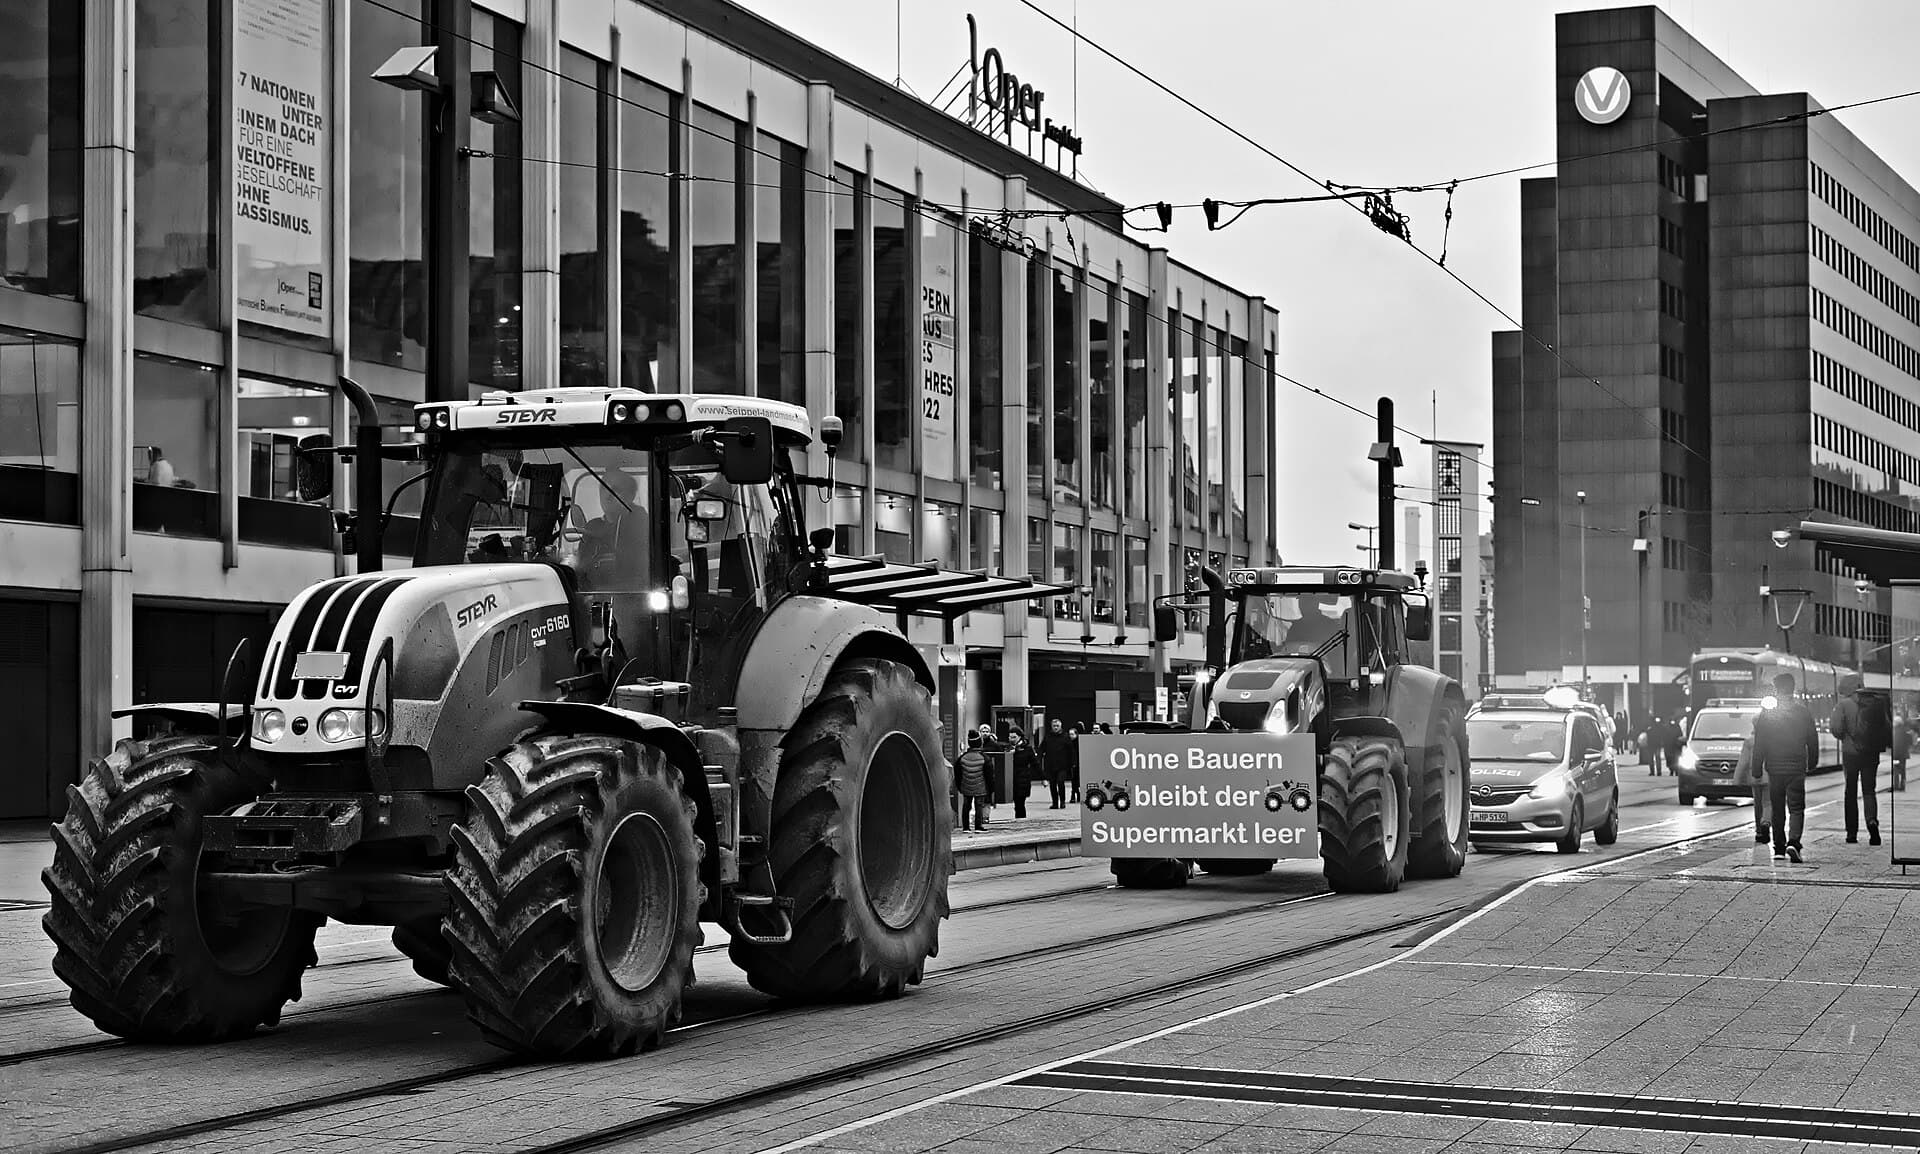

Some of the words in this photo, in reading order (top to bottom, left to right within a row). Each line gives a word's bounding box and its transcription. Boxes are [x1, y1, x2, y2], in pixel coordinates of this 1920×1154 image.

[251, 74, 315, 110] NATIONEN
[983, 48, 1044, 134] Oper
[237, 106, 276, 134] INEM
[281, 121, 315, 146] DACH
[282, 103, 322, 130] UNTER
[240, 125, 264, 149] FÜR
[266, 135, 293, 158] EINE
[237, 201, 312, 235] ASSISMUS.
[924, 369, 953, 397] HRES
[496, 408, 556, 424] STEYR
[923, 397, 940, 421] 22
[457, 593, 498, 629] STEYR
[531, 625, 547, 639] CVT
[546, 614, 570, 633] 6160
[334, 685, 358, 693] CVT
[1110, 747, 1179, 770] Ohne
[1187, 747, 1283, 770] Bauern
[1471, 768, 1522, 777] OLIZEI
[1135, 784, 1208, 807] bleibt
[1215, 784, 1260, 807] der
[1092, 821, 1248, 848] Supermarkt
[1254, 822, 1306, 844] leer
